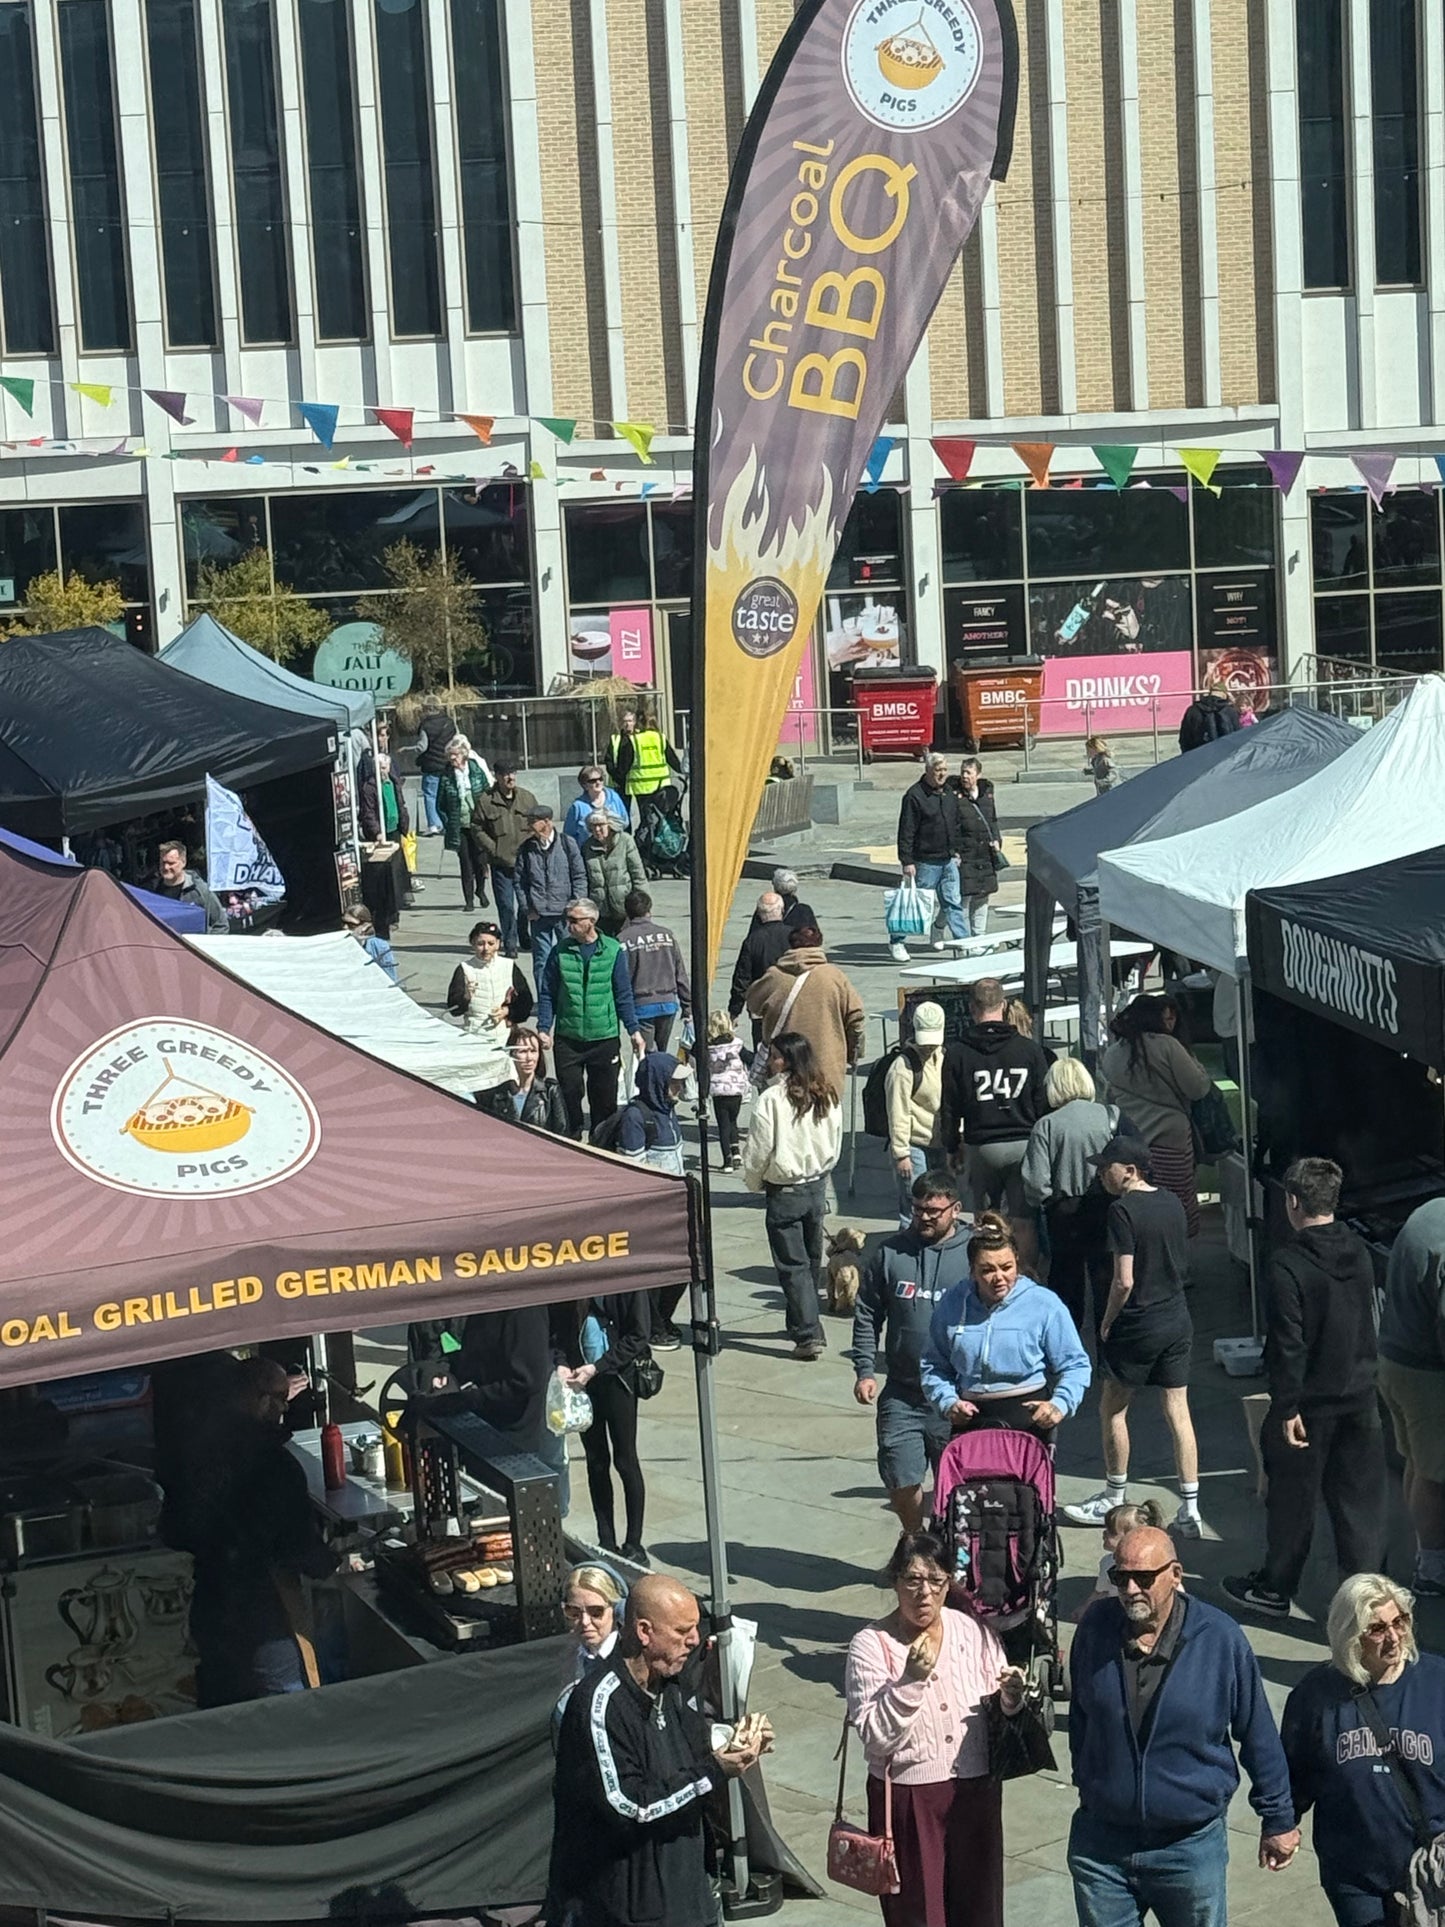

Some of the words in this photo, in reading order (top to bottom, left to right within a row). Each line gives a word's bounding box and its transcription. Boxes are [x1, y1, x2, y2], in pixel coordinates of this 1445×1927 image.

[880, 92, 917, 112] PIGS
[742, 138, 835, 400] Charcoal
[788, 153, 918, 420] BBQ
[750, 594, 781, 610] great
[736, 606, 795, 633] taste
[621, 628, 642, 660] FIZZ
[342, 655, 382, 672] SALT
[981, 689, 1026, 705] BMBC
[1066, 674, 1161, 710] DRINKS?
[873, 702, 919, 717] BMBC
[1280, 918, 1399, 1035] DOUGHNOTTS
[82, 1046, 149, 1115] THREE
[156, 1039, 272, 1094] GREEDY
[973, 1068, 1029, 1102] 247
[177, 1154, 249, 1178] PIGS
[0, 1311, 82, 1347] OAL
[93, 1276, 264, 1331] GRILLED
[275, 1256, 442, 1300] GERMAN
[454, 1231, 630, 1279] SAUSAGE
[1336, 1726, 1434, 1766] CHIAGO
